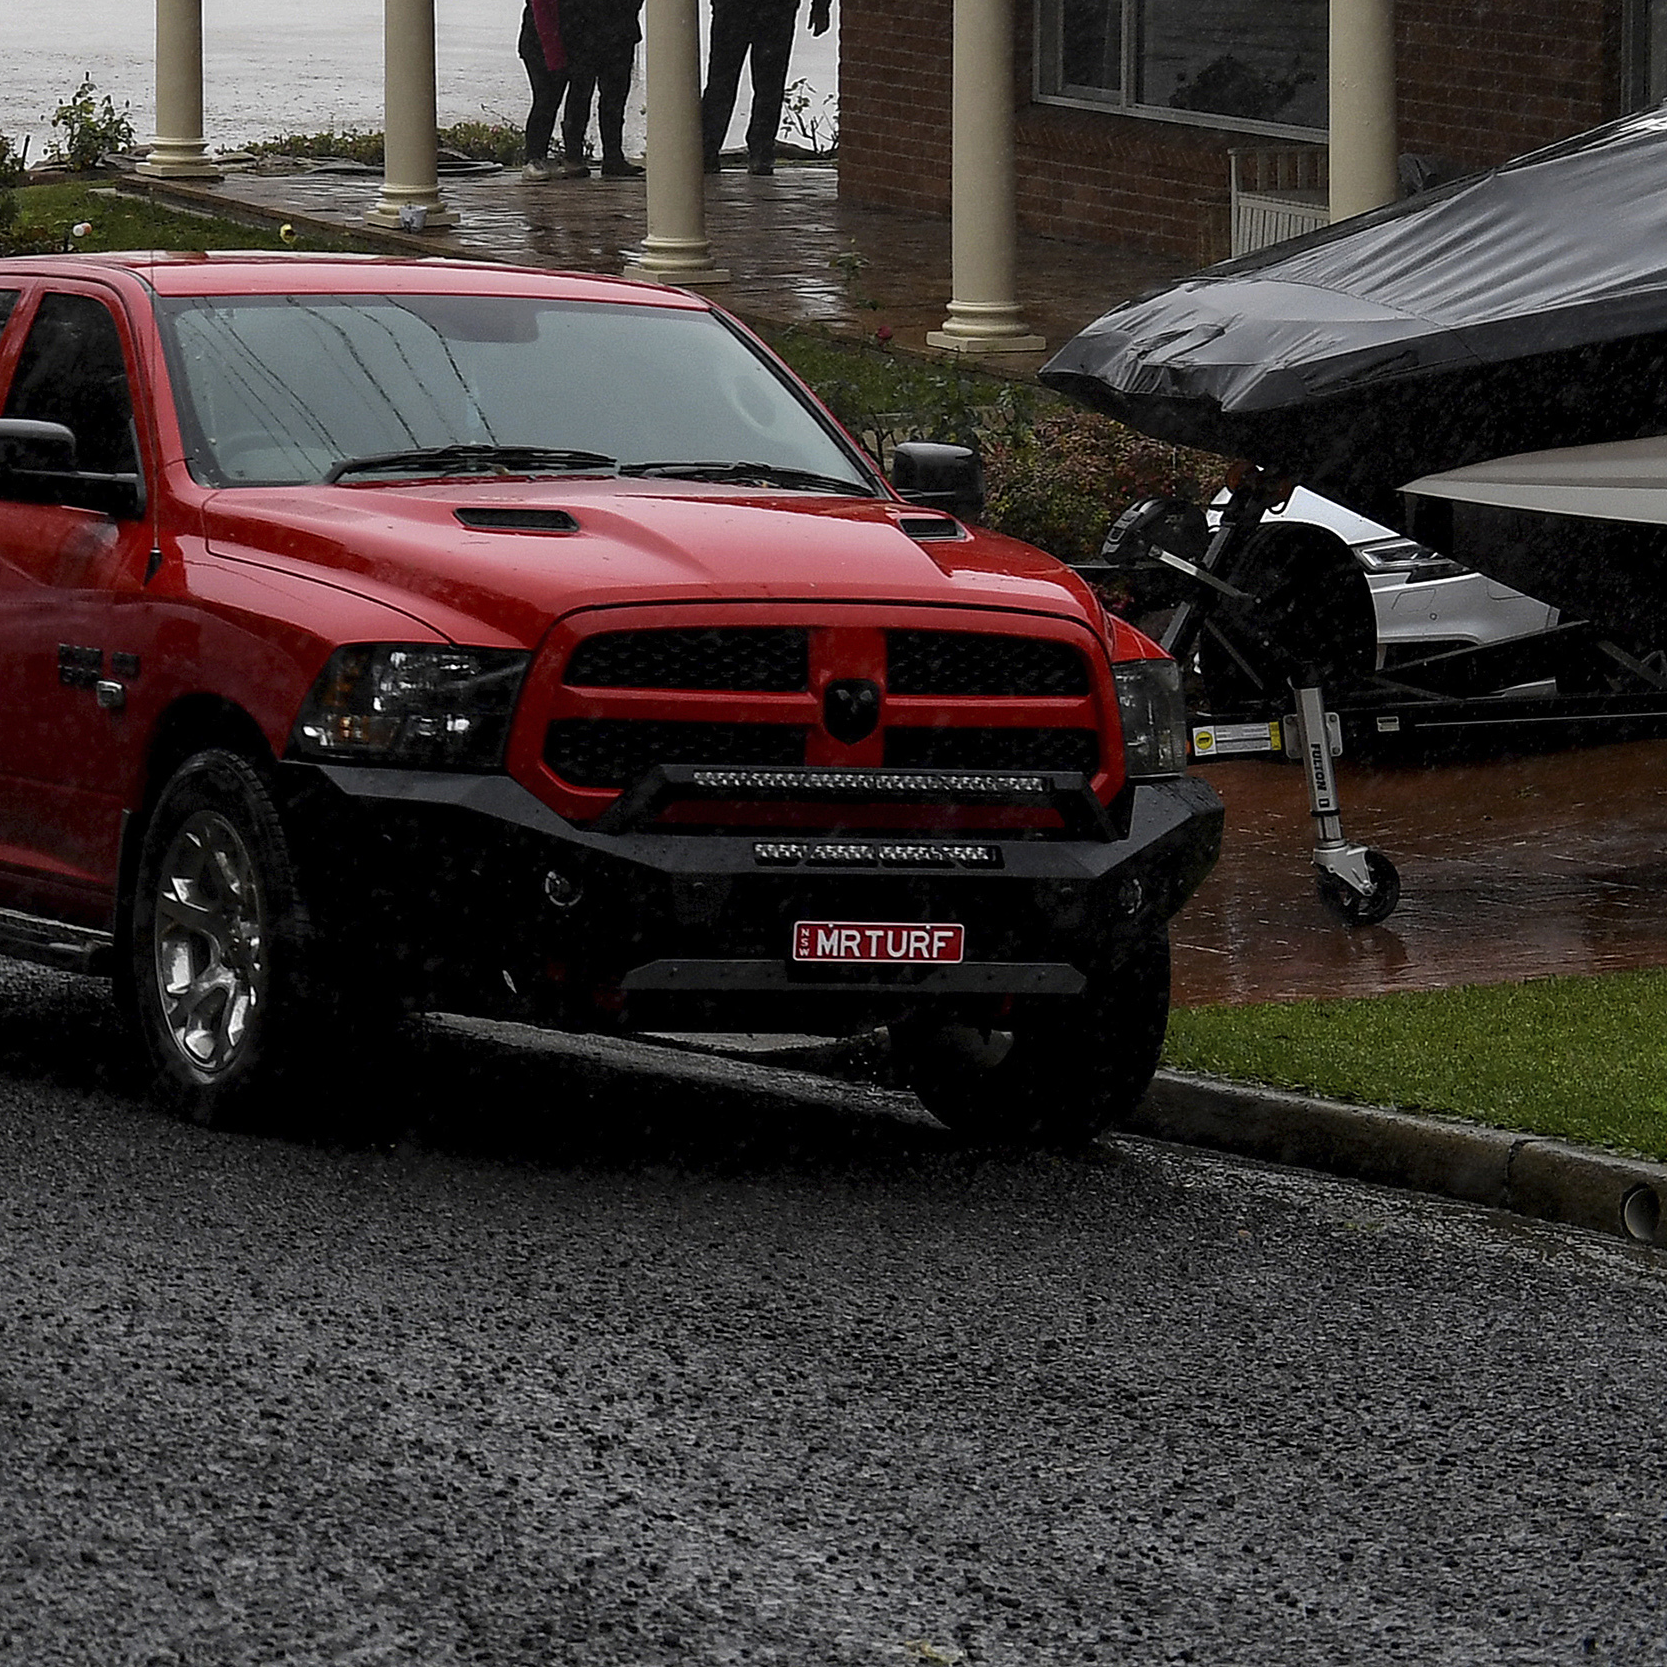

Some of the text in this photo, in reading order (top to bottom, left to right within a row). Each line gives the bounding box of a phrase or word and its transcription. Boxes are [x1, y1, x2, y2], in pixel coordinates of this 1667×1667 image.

[1310, 743, 1327, 792] FULTON
[799, 928, 811, 957] NSW
[816, 928, 955, 959] MRTURF
